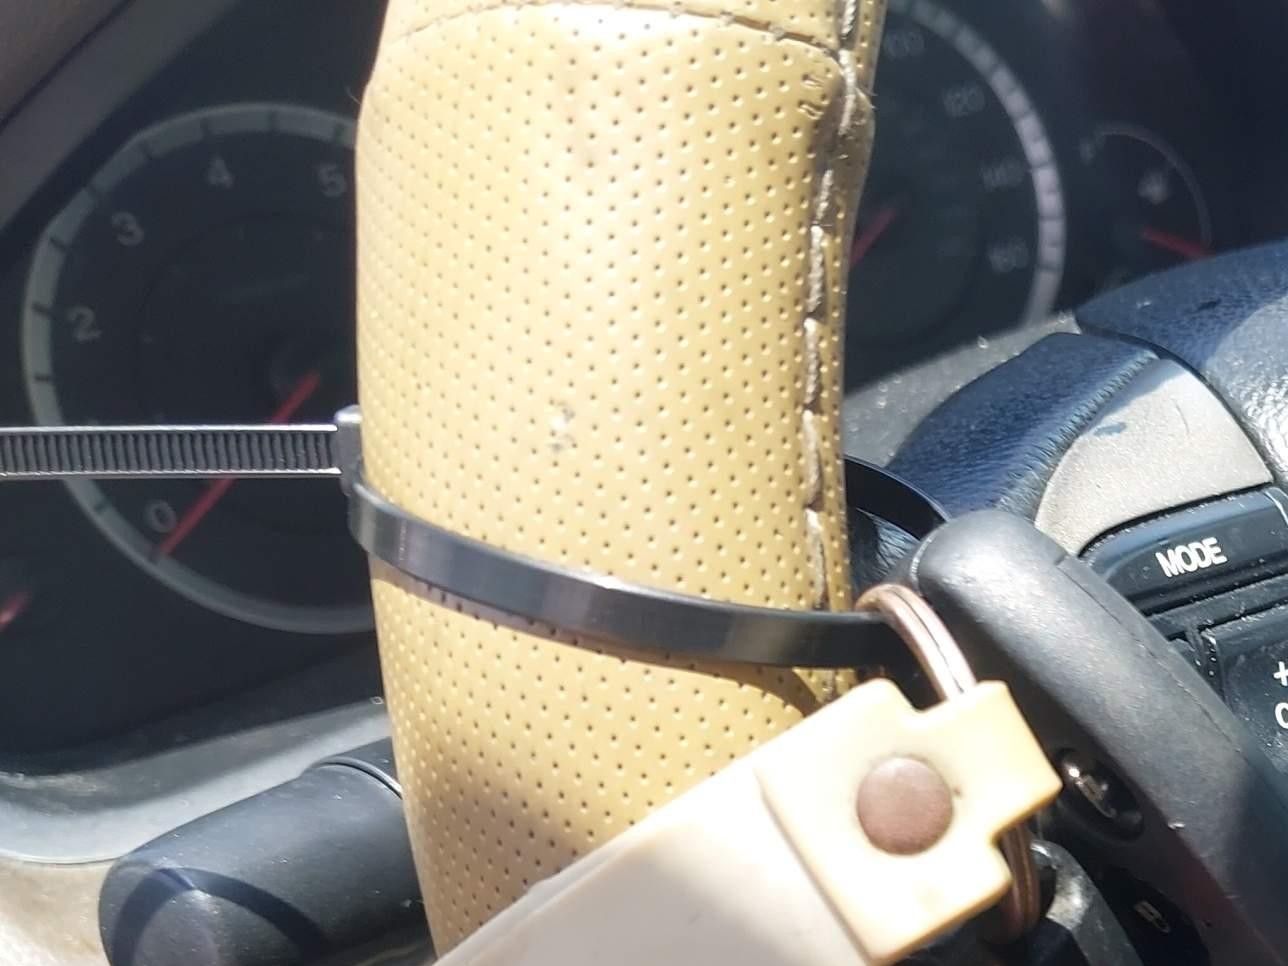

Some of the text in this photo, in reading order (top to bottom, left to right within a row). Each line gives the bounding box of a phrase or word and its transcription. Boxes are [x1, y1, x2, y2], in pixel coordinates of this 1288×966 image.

[206, 155, 234, 189] 4
[317, 163, 347, 198] 5
[111, 211, 145, 247] 3
[68, 305, 101, 342] 2
[145, 498, 177, 534] 0
[1155, 536, 1228, 578] MODE
